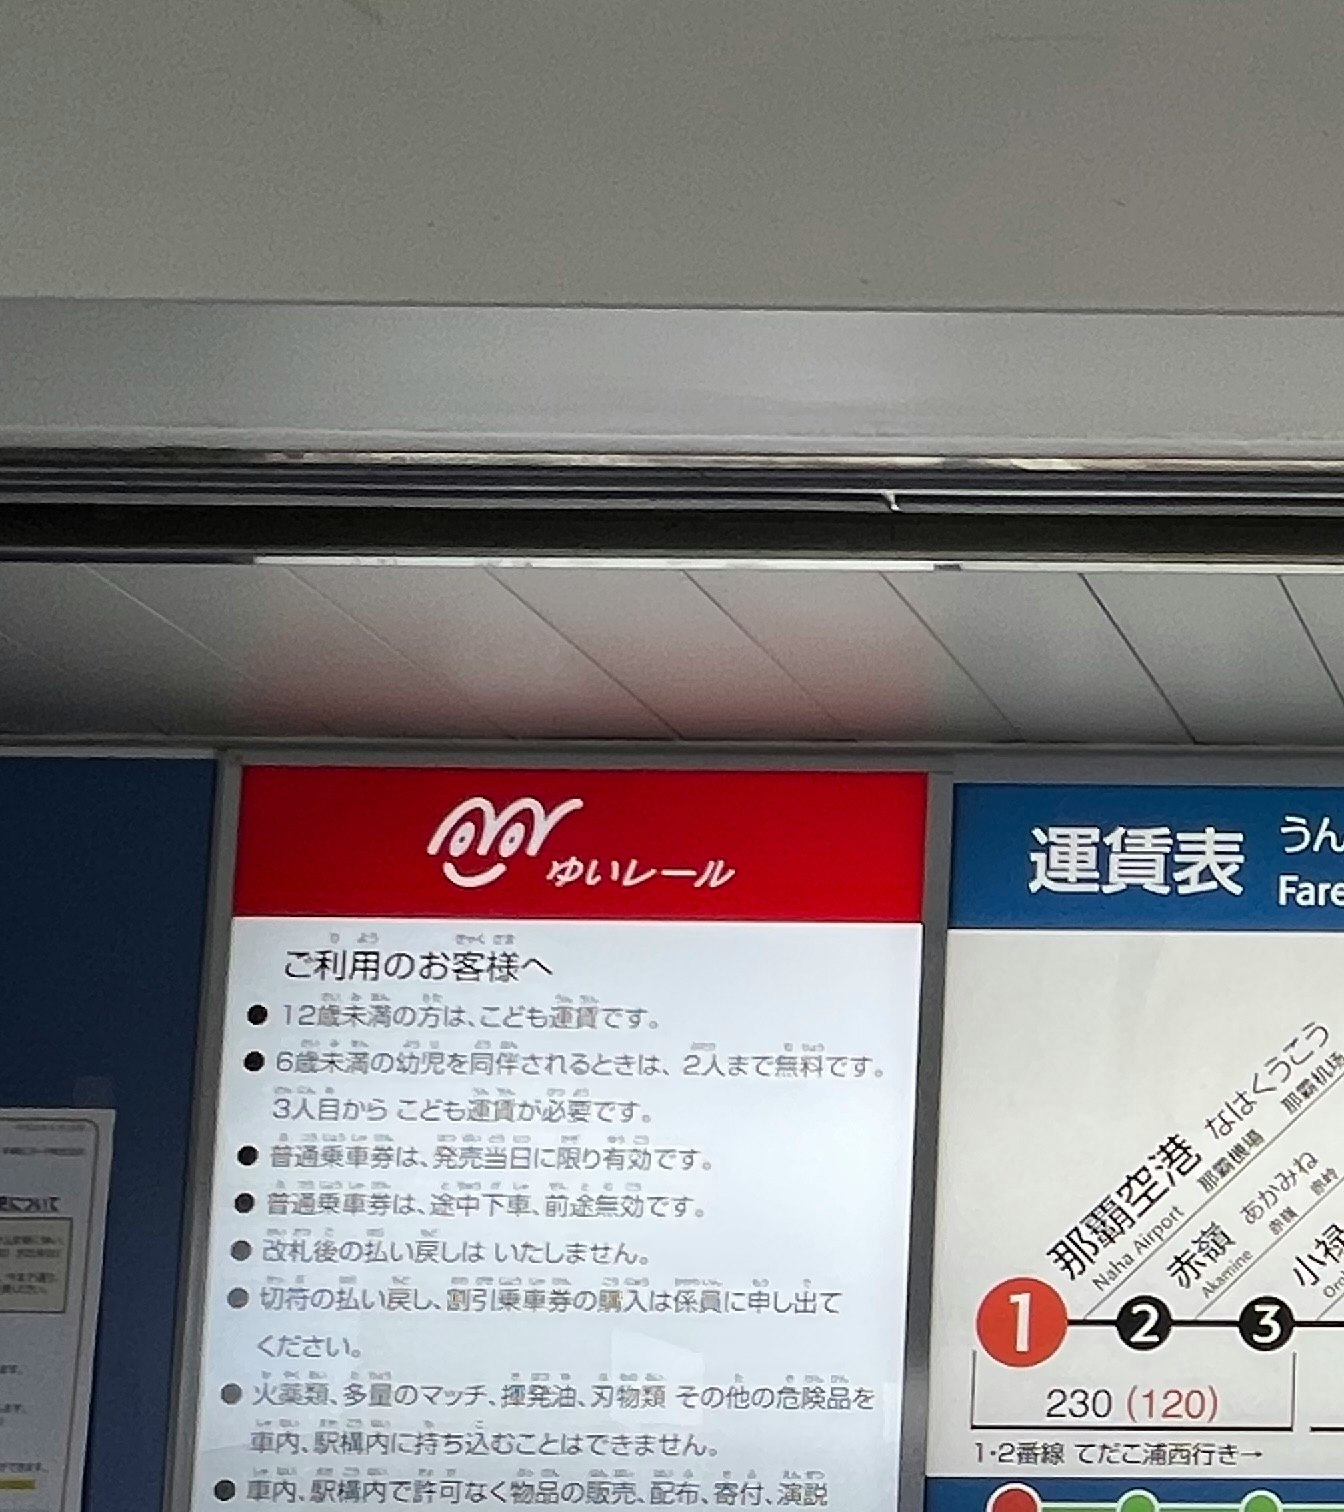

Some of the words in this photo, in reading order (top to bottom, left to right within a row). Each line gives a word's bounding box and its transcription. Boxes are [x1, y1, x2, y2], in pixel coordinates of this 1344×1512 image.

[546, 859, 736, 886] ゆいレール
[1029, 827, 1245, 897] 運賃表
[284, 947, 553, 983] ご利用のお客様へ
[282, 1002, 661, 1032] 12歳未満の方は、こども運賃です。
[1046, 1133, 1202, 1282] 那覇空港
[1203, 1019, 1332, 1141] なはくうこう
[1238, 1150, 1320, 1227] あかみね
[1091, 1247, 1136, 1292] Naha
[1132, 1204, 1188, 1256] Airport
[255, 1334, 363, 1361] ください。
[1046, 1388, 1113, 1422] 230
[1126, 1387, 1219, 1424] (120)
